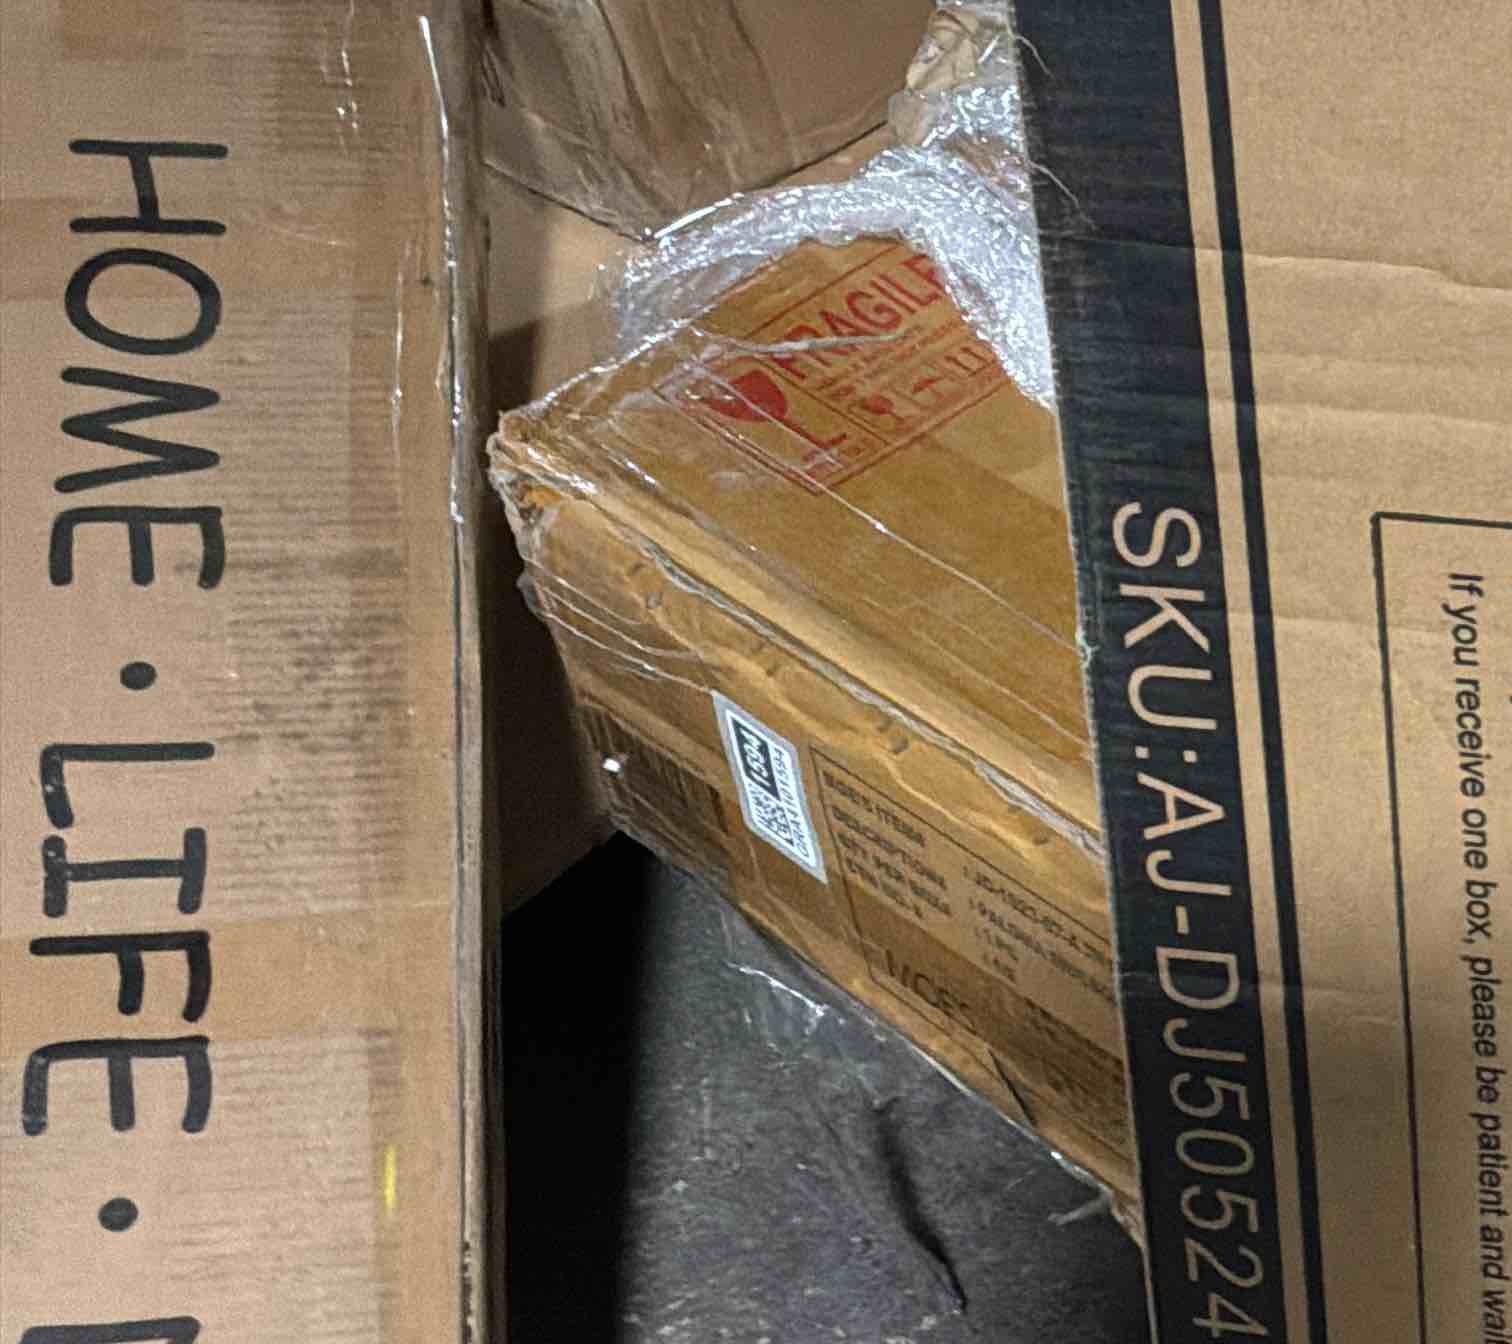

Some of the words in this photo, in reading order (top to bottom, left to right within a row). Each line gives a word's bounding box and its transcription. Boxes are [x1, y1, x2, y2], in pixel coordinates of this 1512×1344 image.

[49, 137, 230, 589] HOME
[1448, 573, 1485, 597] If
[1442, 603, 1481, 670] you
[740, 729, 774, 788] 1594
[1455, 677, 1493, 799] receive
[1461, 808, 1489, 870] one
[21, 740, 216, 1137] LIFE
[1462, 877, 1499, 945] box,
[1465, 954, 1507, 1057] please
[1476, 1065, 1506, 1106] be
[1470, 1111, 1512, 1218] patient
[1479, 1223, 1512, 1282] and
